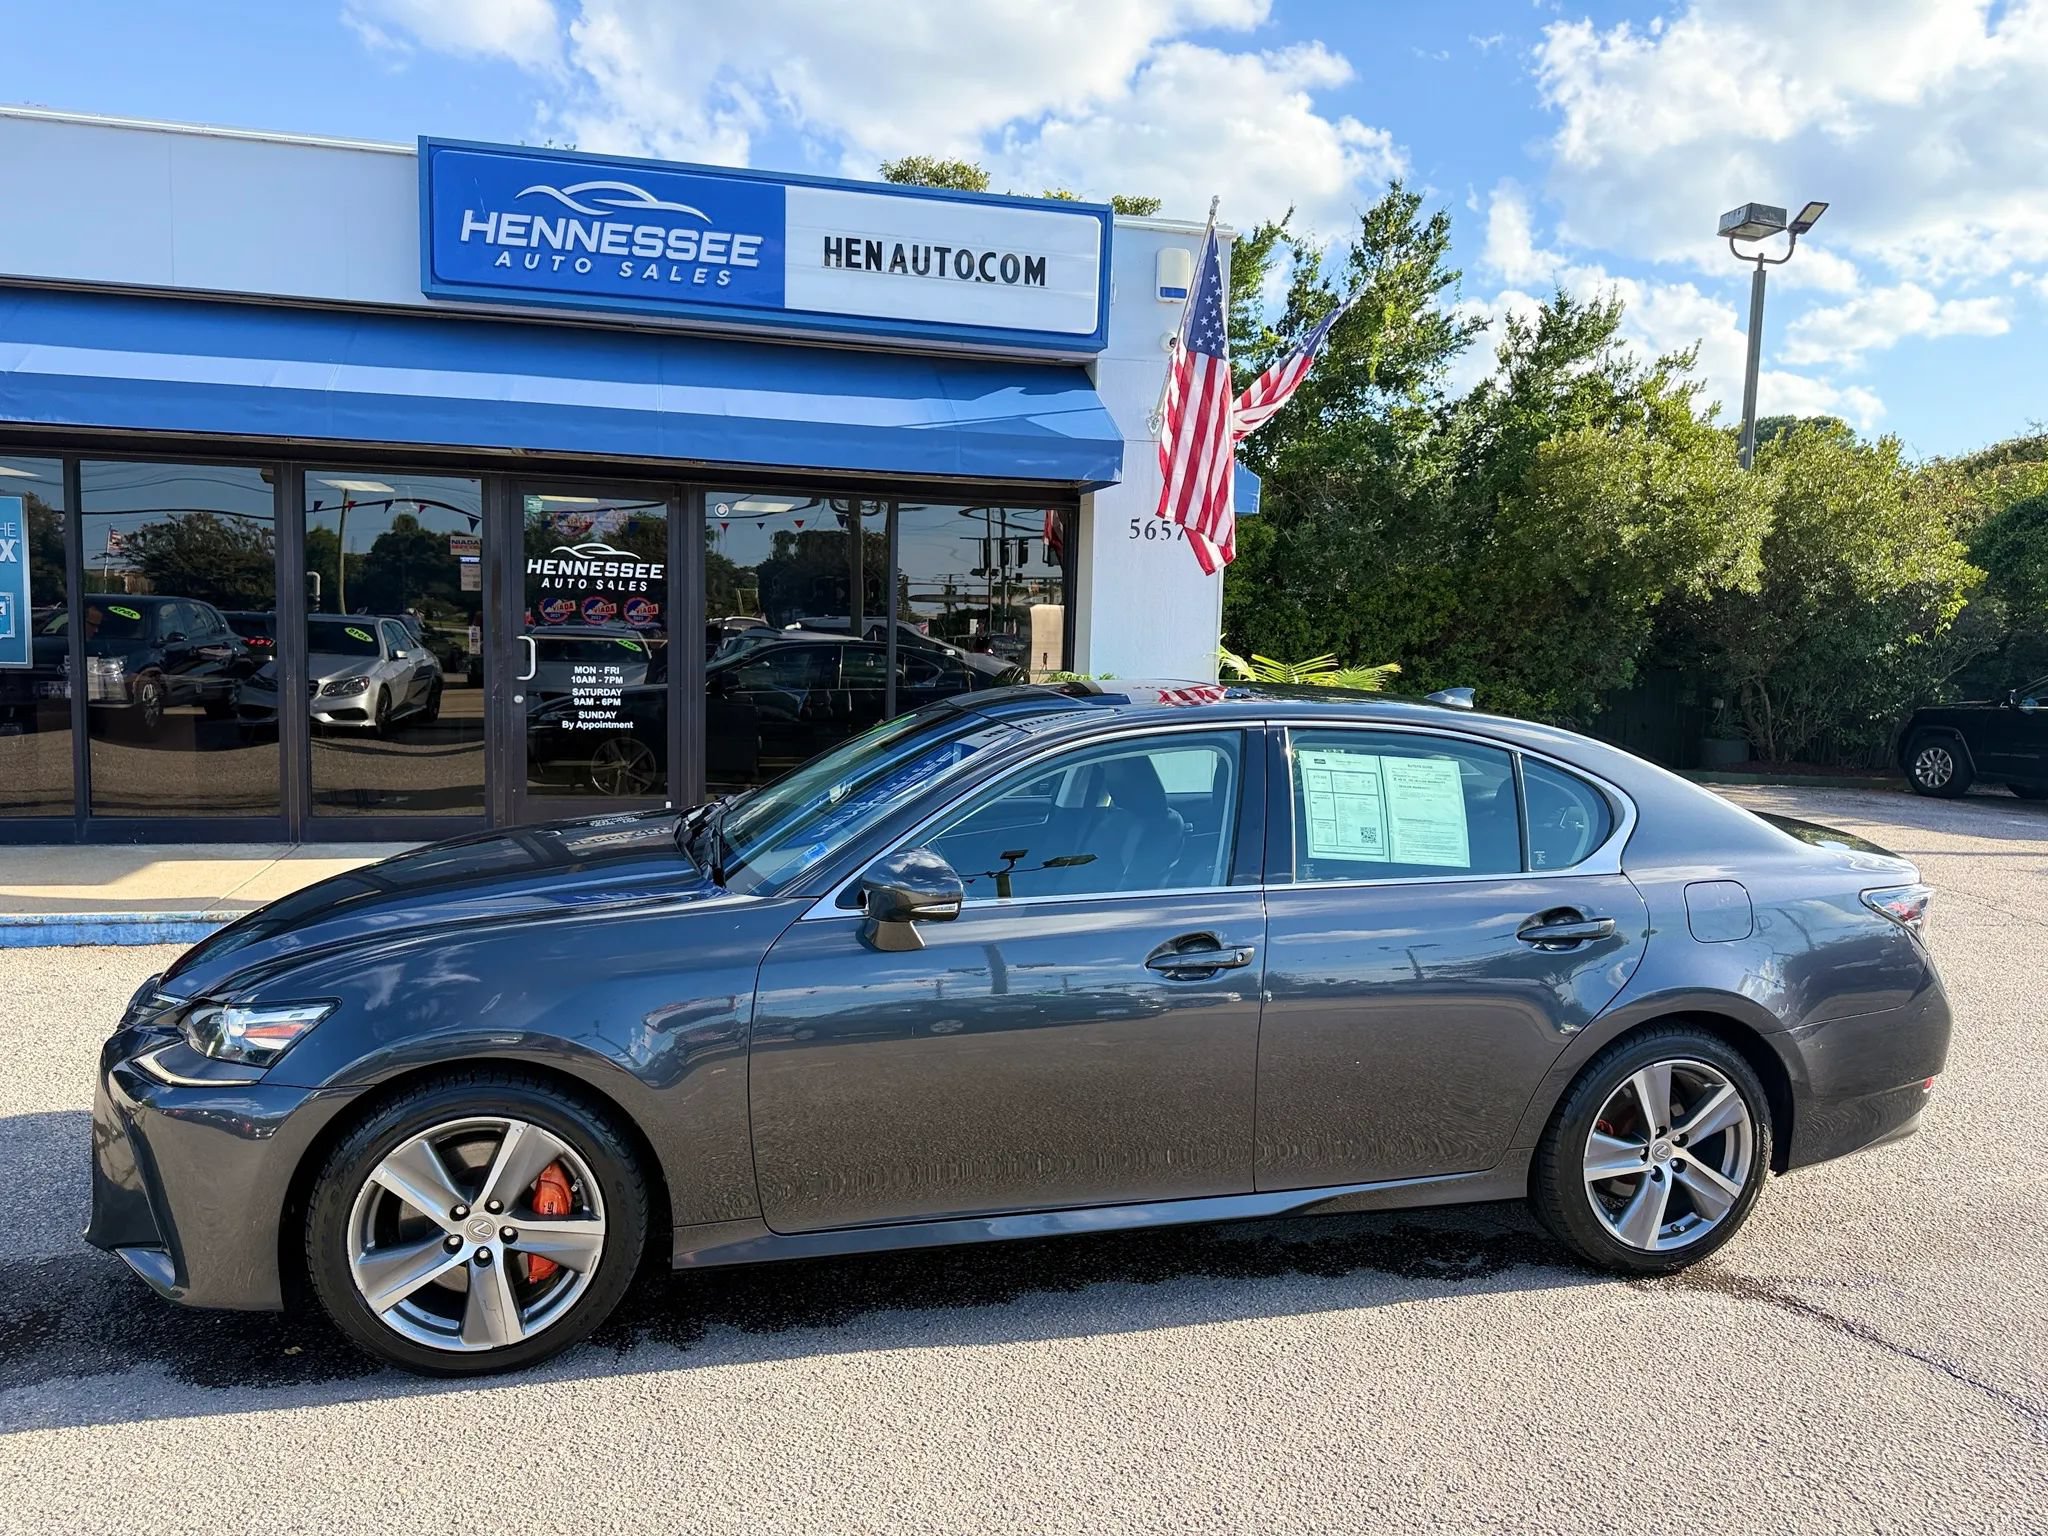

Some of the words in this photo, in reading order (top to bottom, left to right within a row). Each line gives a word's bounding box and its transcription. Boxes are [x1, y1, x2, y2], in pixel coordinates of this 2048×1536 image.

[460, 209, 764, 267] HENNESSEE
[494, 250, 593, 274] AUTO
[618, 261, 732, 286] SALES
[1129, 517, 1186, 541] 5657
[526, 559, 664, 579] HENNESSEE
[541, 577, 588, 590] AUTO
[595, 579, 648, 592] SALES
[574, 665, 596, 674] MON
[604, 666, 620, 674] FRI
[571, 675, 596, 684] 10AM
[604, 676, 624, 684] 7PM
[572, 688, 623, 697] SATURDAY
[573, 697, 594, 706] 9AM
[601, 698, 621, 706] 6PM
[578, 710, 617, 719] SUNDAY
[562, 720, 574, 730] By
[576, 720, 634, 730] Appointment
